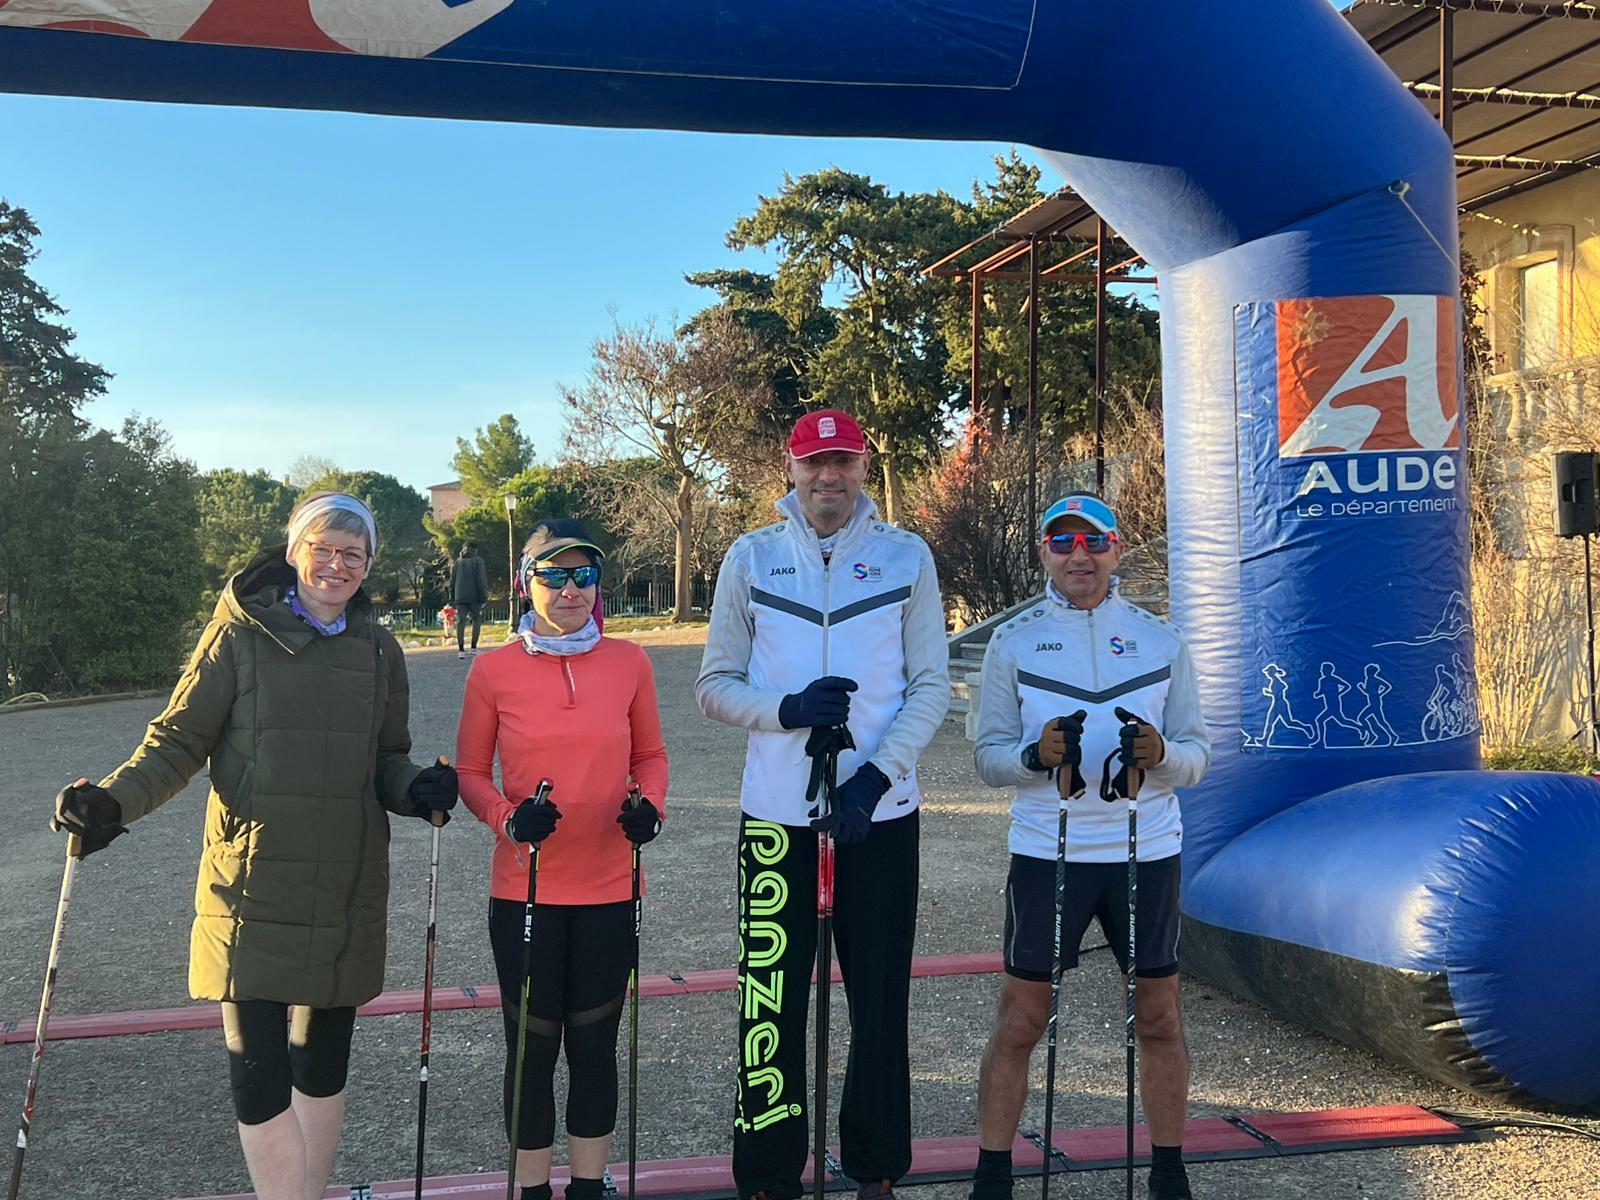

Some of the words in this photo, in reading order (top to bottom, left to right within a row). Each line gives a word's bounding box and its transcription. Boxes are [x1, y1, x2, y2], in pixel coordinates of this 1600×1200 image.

[769, 566, 796, 576] JAKO
[1035, 642, 1063, 652] JAKO
[523, 903, 533, 942] LEKI
[1053, 913, 1062, 958] GUIDETTI
[1128, 913, 1136, 958] GUIDETTI
[744, 820, 790, 1132] panzeri
